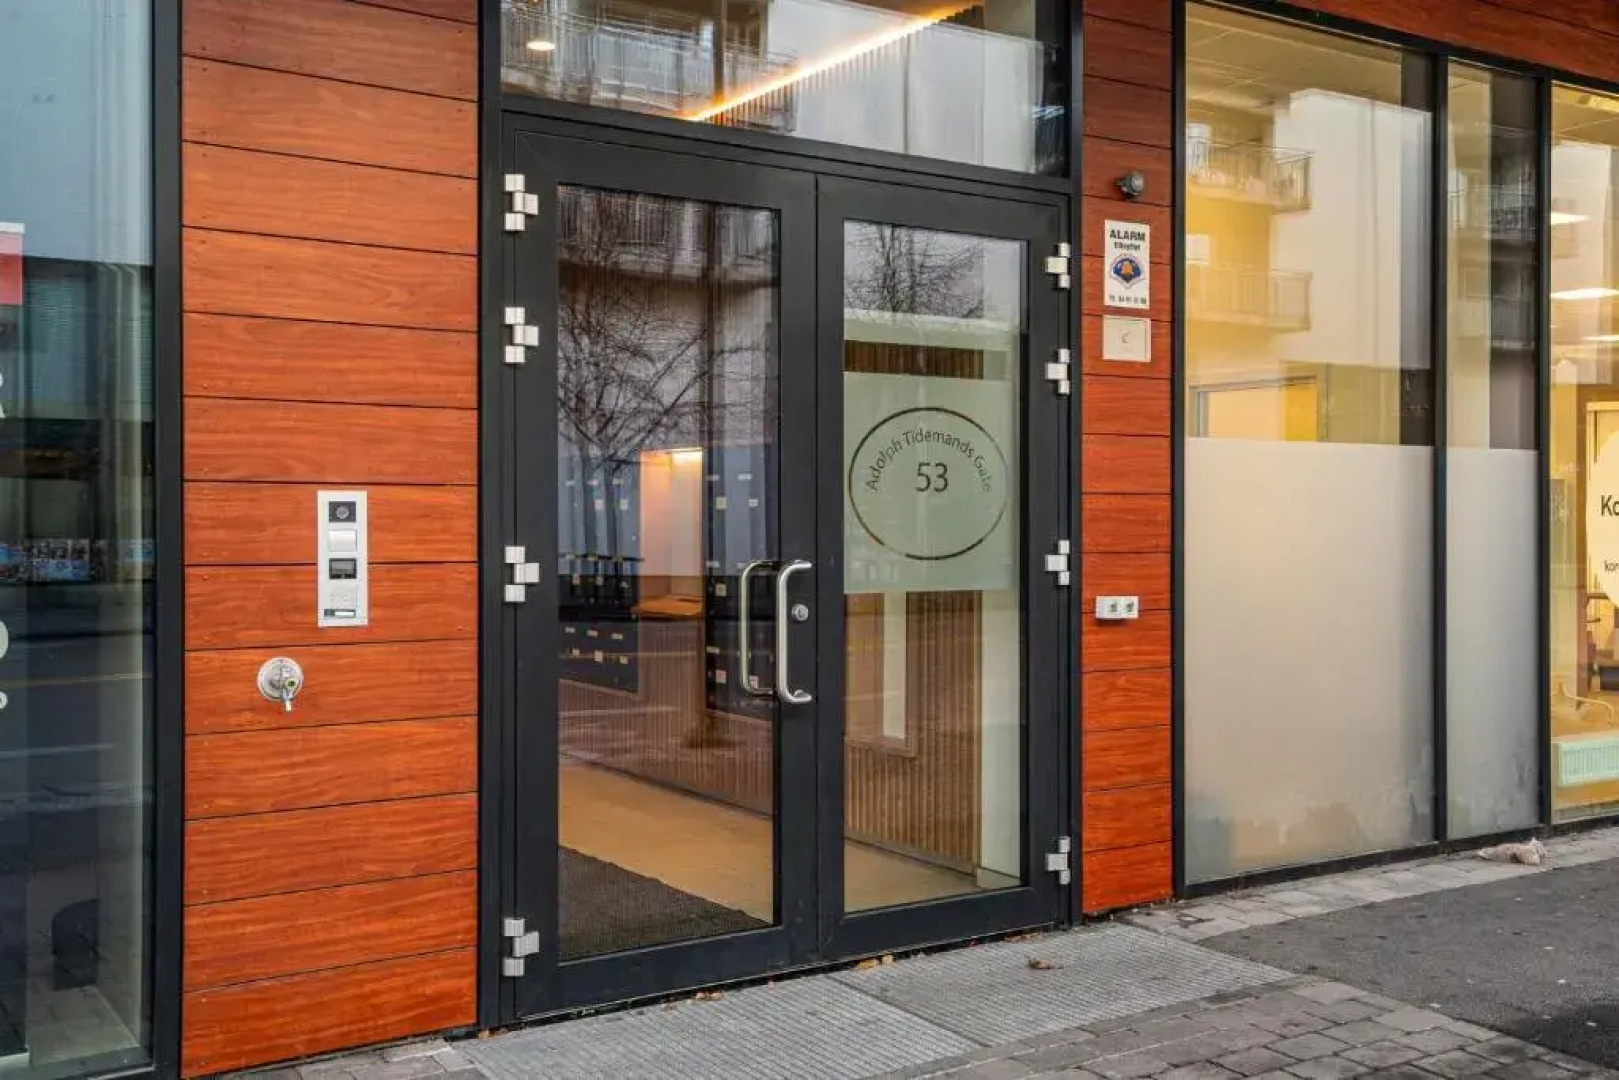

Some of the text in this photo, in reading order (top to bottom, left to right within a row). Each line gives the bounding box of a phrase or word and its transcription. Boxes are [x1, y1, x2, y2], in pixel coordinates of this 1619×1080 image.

[1109, 229, 1146, 241] ALARM
[865, 438, 904, 492] Adolph
[902, 427, 975, 458] Tidemands
[915, 462, 949, 492] 53
